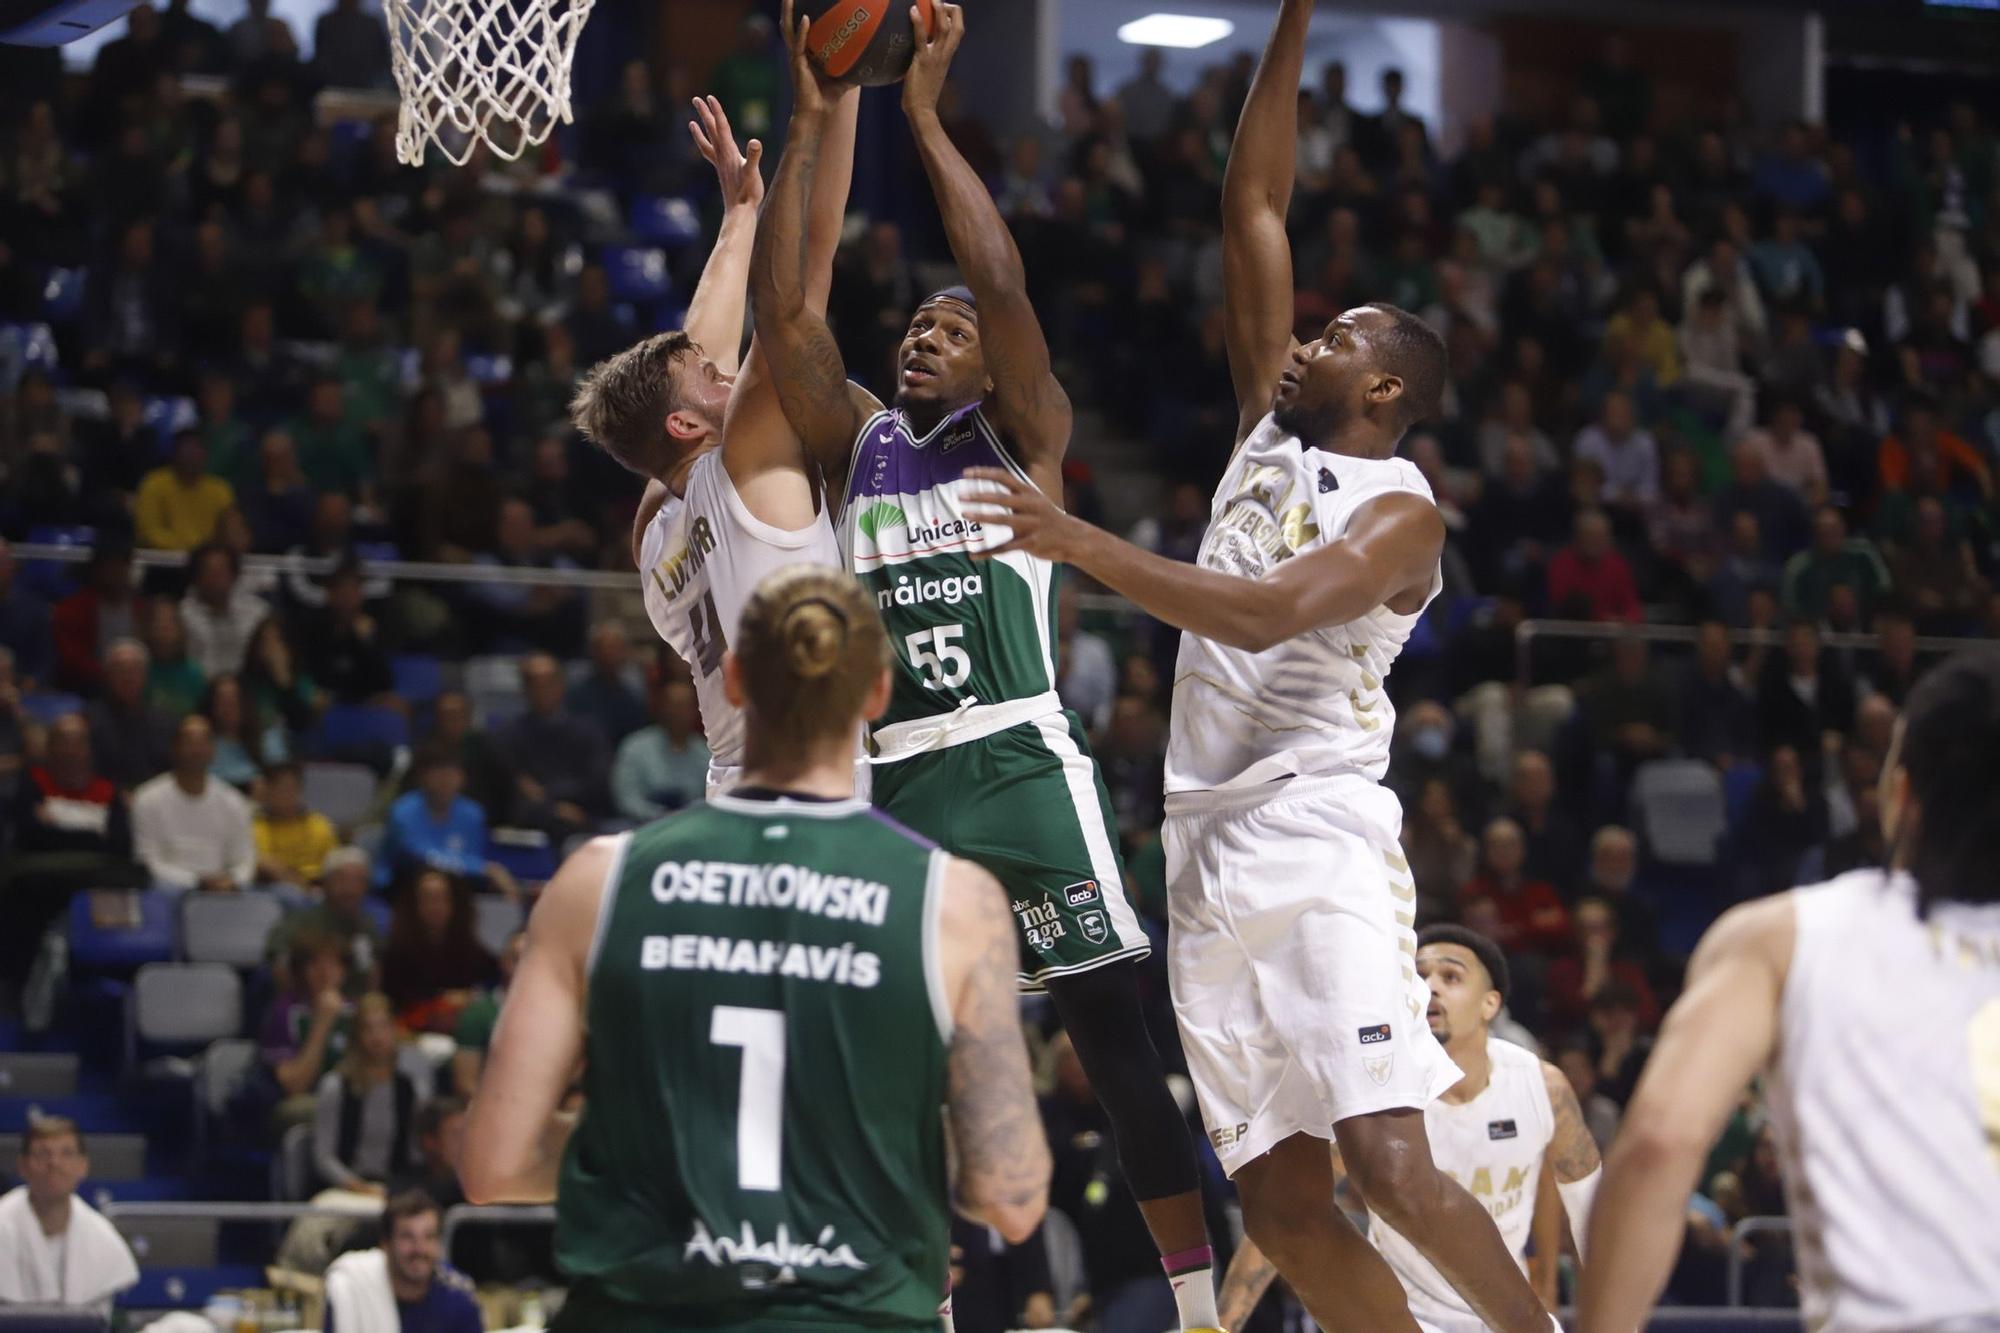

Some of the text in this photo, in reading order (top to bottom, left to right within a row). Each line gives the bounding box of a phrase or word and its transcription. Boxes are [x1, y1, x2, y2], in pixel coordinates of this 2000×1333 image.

[905, 624, 971, 691] 55
[651, 860, 890, 926] OSETKOWSKI
[1069, 889, 1092, 904] acb
[1361, 1031, 1385, 1043] acb
[709, 1004, 786, 1191] 1
